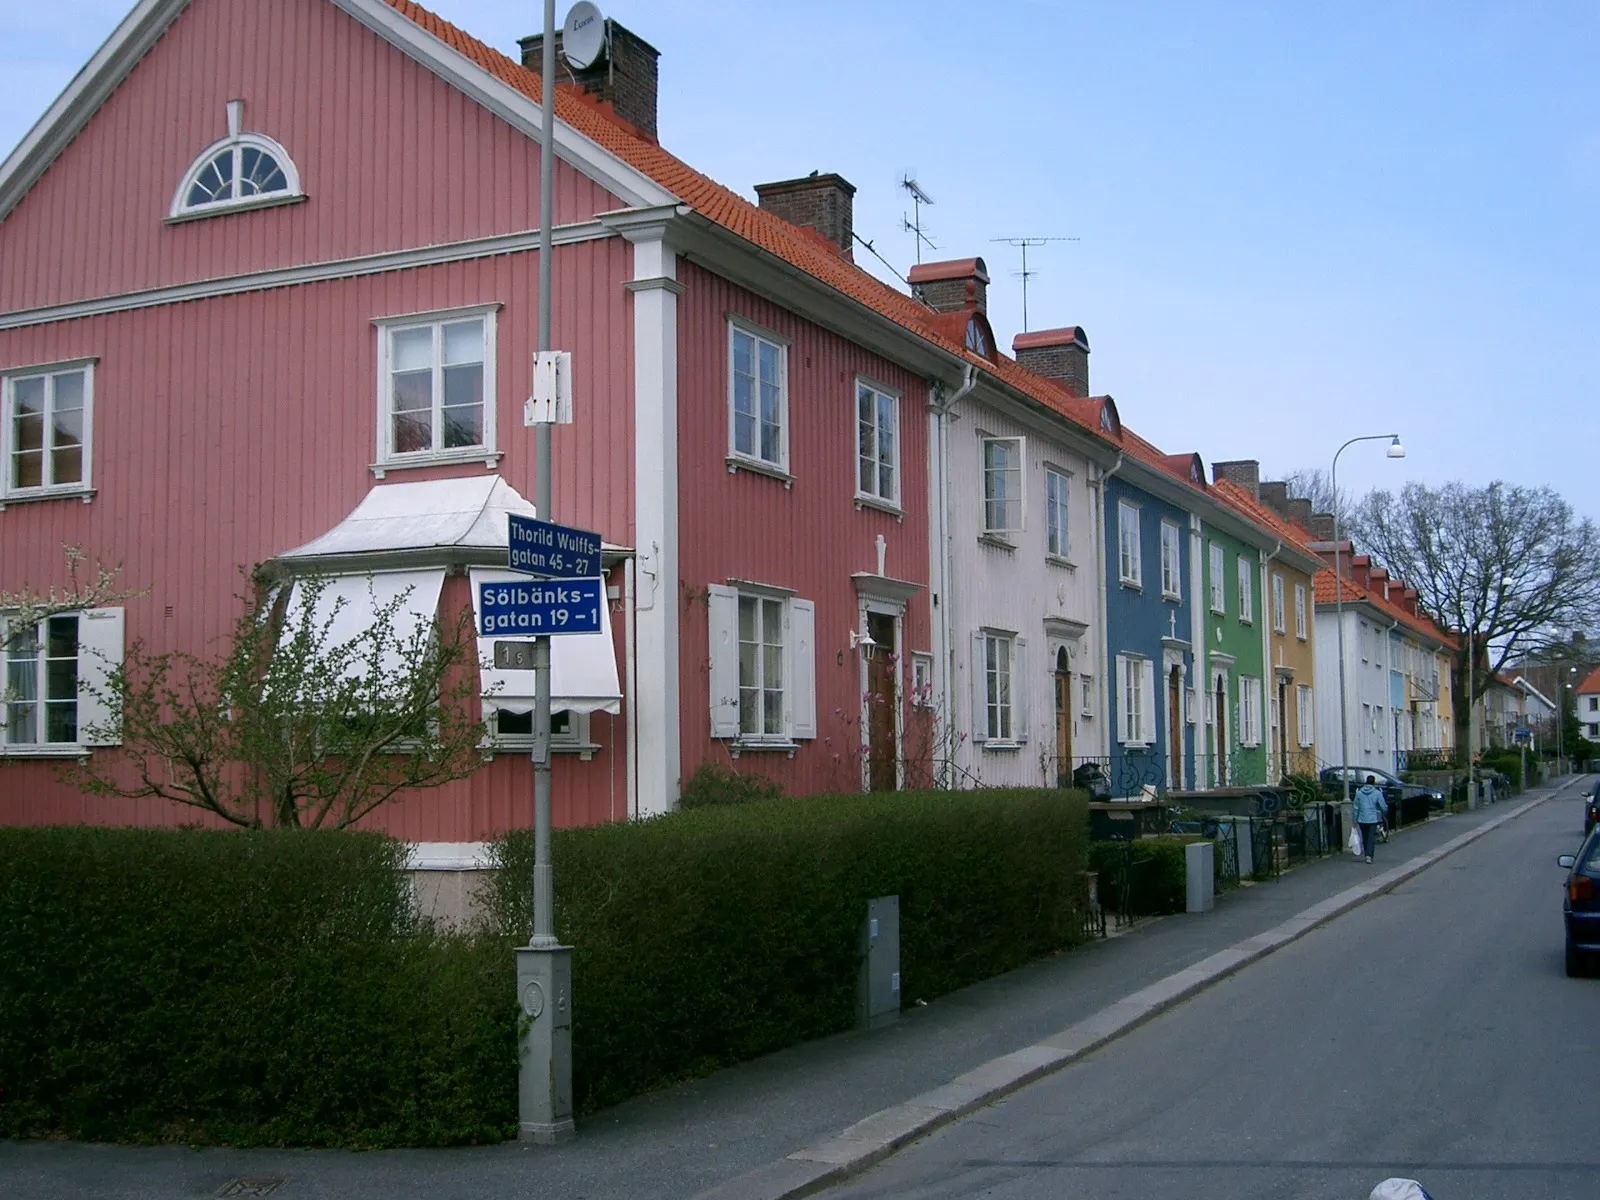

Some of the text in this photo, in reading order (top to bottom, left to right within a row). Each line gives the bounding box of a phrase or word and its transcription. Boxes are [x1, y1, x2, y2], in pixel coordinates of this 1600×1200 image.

[511, 523, 600, 555] Thorild Wulffs-
[512, 549, 545, 566] gatan
[549, 553, 563, 570] 45
[576, 558, 589, 575] 27
[484, 587, 595, 606] Sölbänks-
[484, 612, 542, 632] gatan
[550, 609, 569, 626] 19
[591, 608, 597, 625] 1
